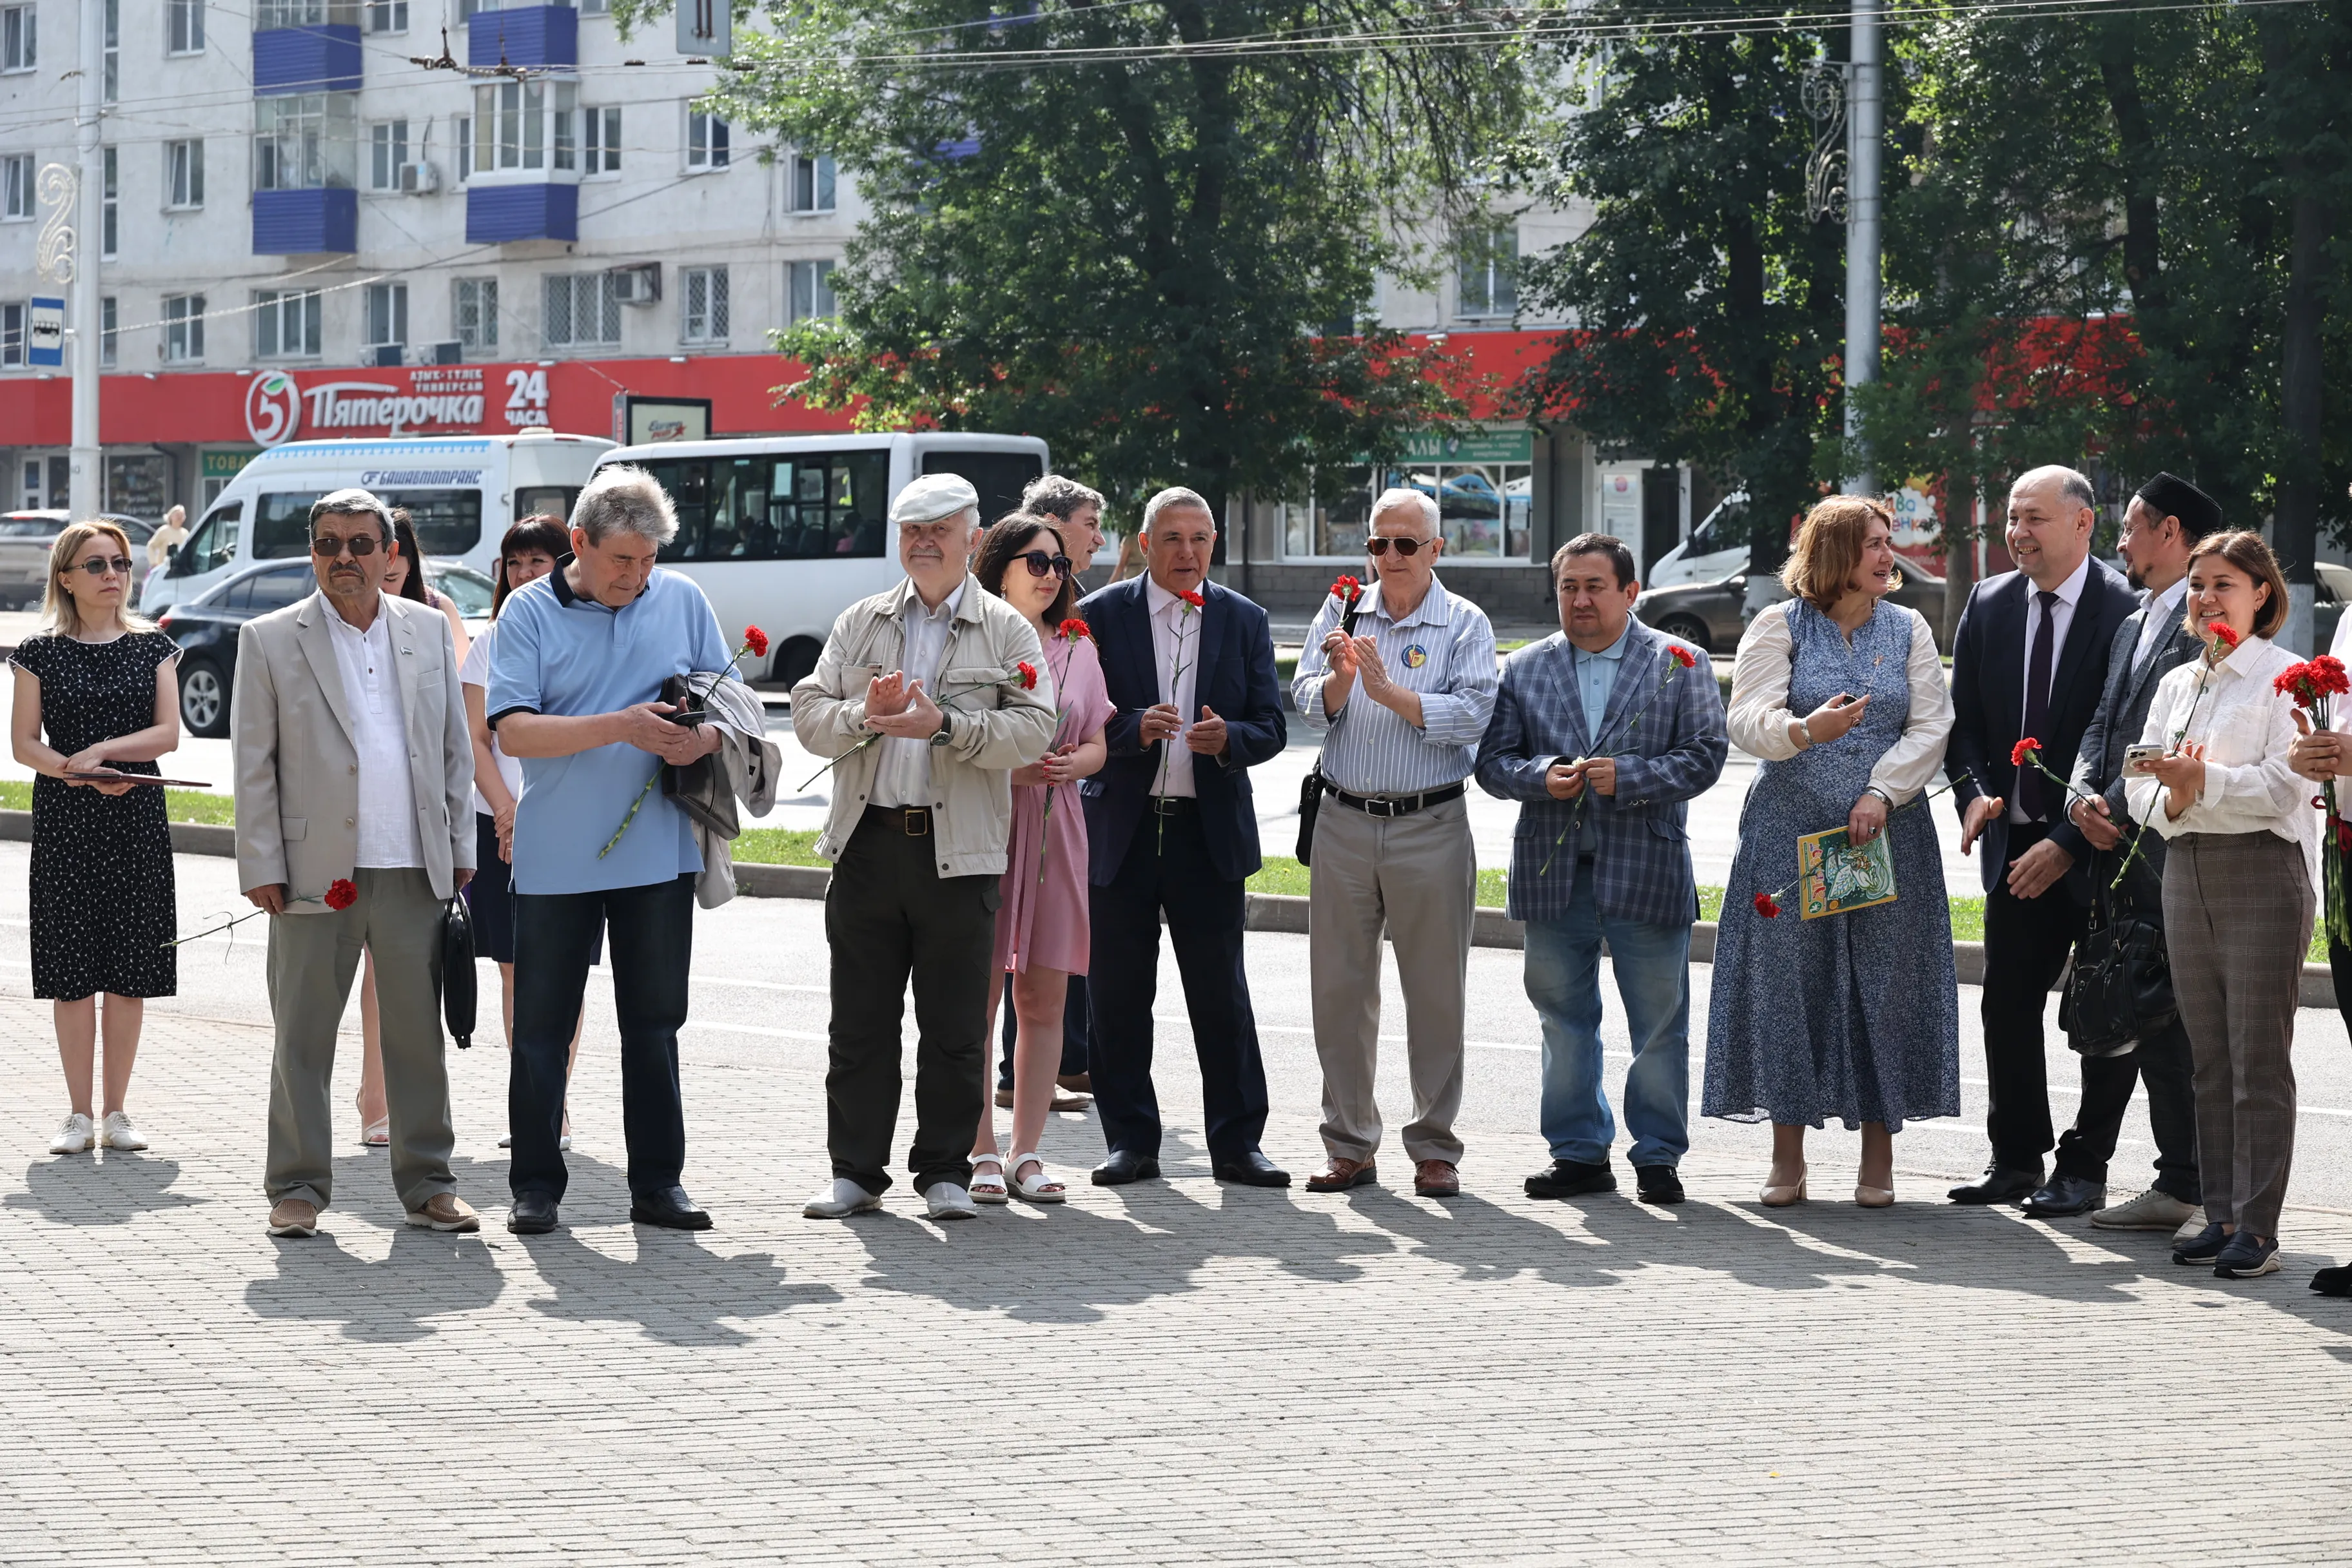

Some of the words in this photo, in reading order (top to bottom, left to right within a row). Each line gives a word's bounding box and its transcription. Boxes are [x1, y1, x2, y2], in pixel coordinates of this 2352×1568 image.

[415, 382, 484, 393] УНИВЕРСАМ
[505, 370, 549, 408] 24
[505, 410, 549, 426] ЧАСА
